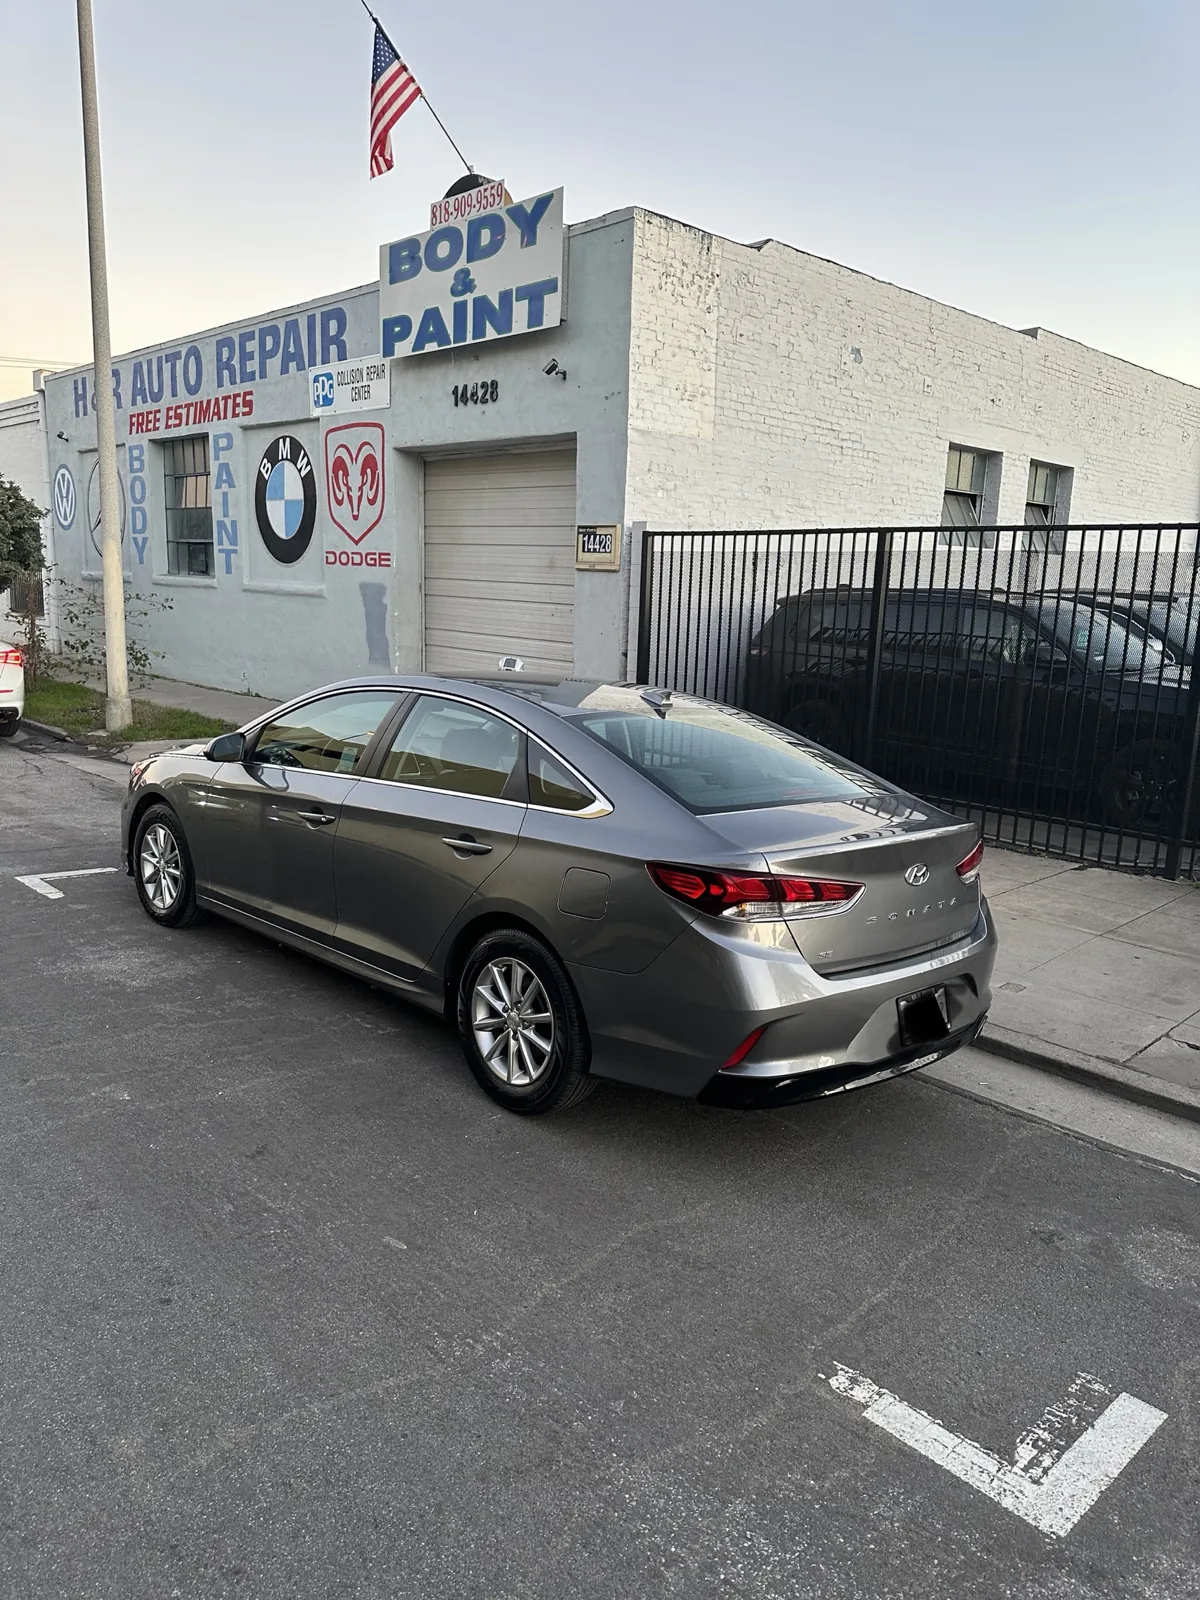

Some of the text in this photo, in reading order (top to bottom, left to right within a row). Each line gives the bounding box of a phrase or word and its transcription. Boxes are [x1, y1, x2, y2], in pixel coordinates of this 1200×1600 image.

[431, 182, 503, 226] 818-909-9559
[389, 193, 554, 285] BODY
[450, 267, 477, 298] &
[382, 276, 558, 359] PAINT
[131, 345, 203, 407] AUTO
[215, 306, 348, 388] REPAIR
[337, 363, 386, 387] COLLISION REPAIR
[314, 376, 334, 405] PPG
[351, 384, 371, 402] CENTER
[452, 380, 499, 407] 14428
[129, 390, 254, 435] FREE ESTIMATES
[260, 437, 312, 481] BMW
[128, 444, 148, 565] BODY
[212, 432, 239, 575] PAINT
[325, 551, 391, 568] DODGE
[583, 534, 612, 552] 14428
[866, 897, 958, 925] SONATA
